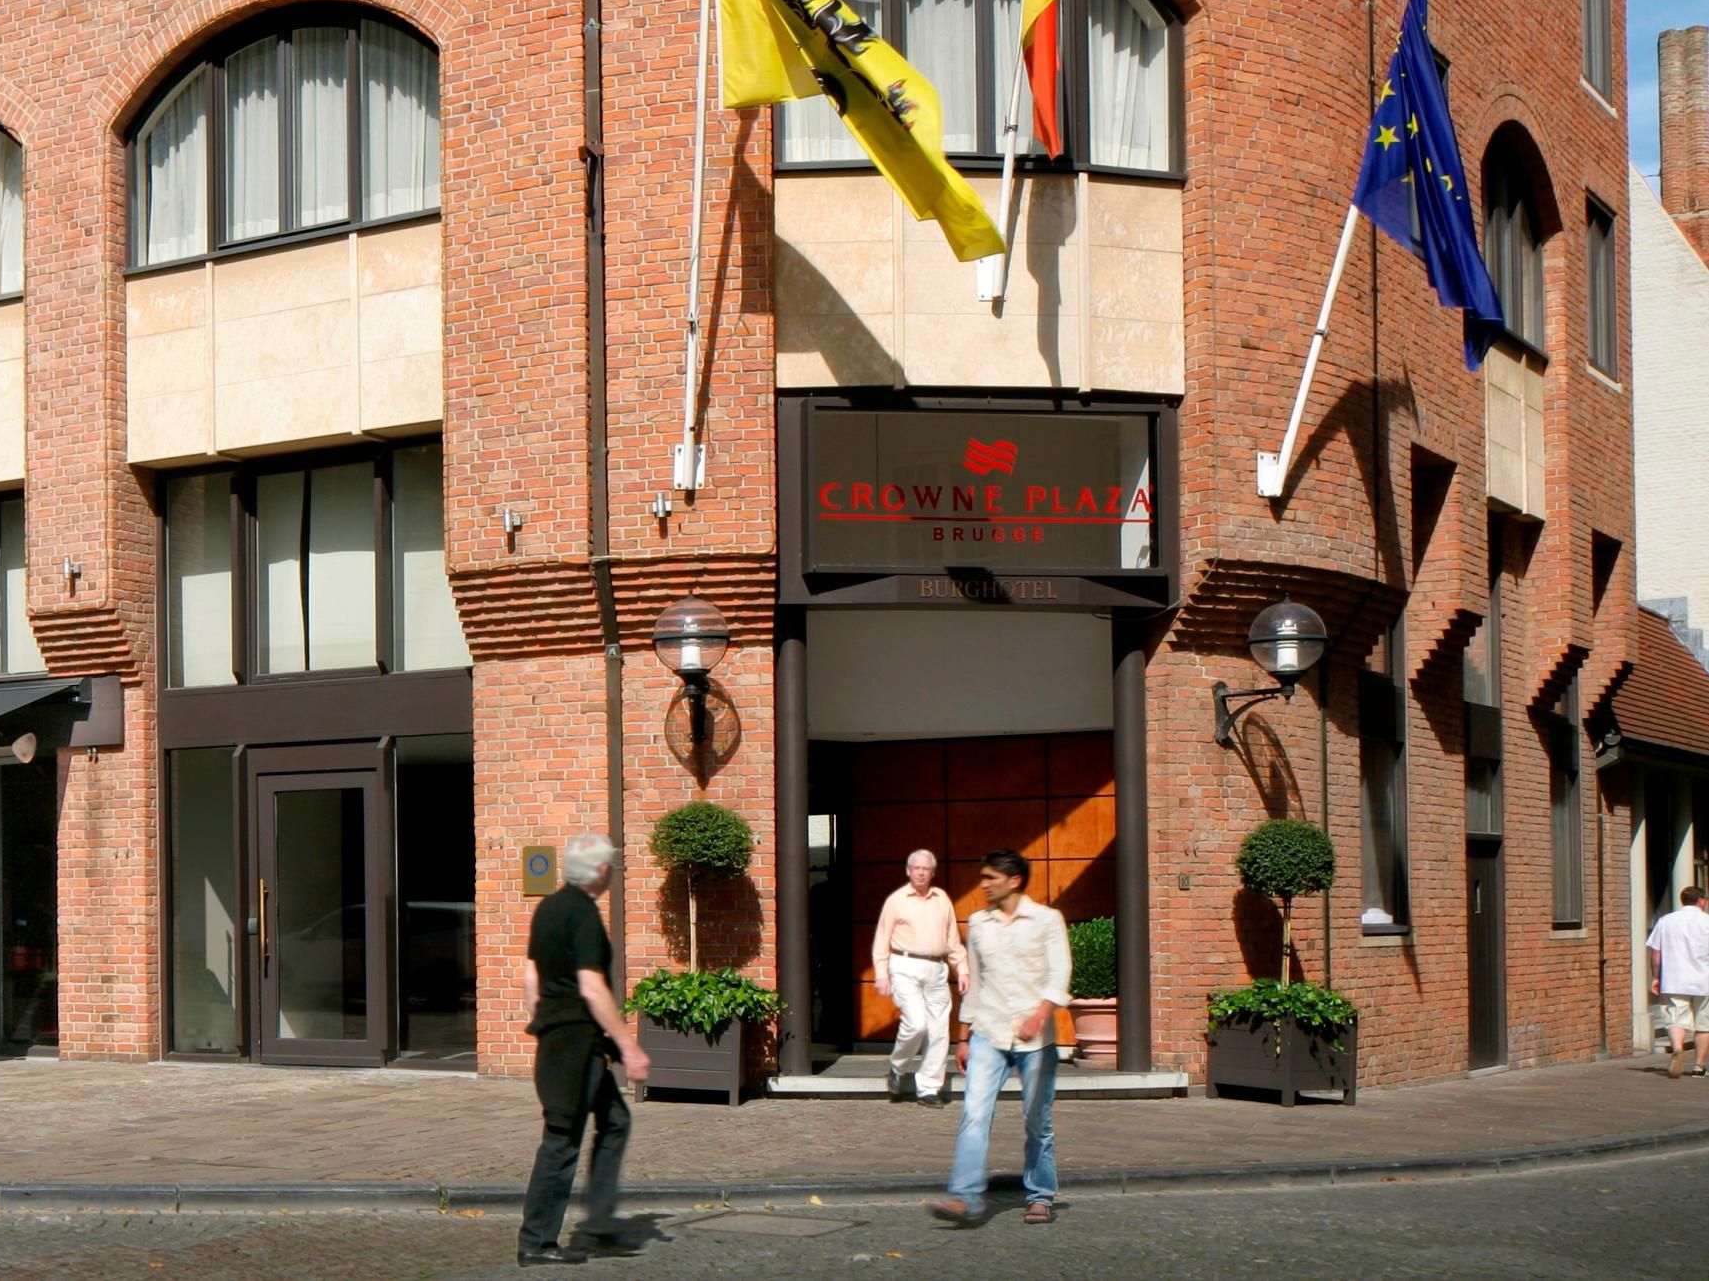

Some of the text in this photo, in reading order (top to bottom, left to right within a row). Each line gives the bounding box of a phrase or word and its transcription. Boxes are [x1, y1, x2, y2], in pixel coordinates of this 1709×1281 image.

[819, 482, 1153, 514] CROWNE PLAZA
[932, 526, 1044, 543] BRUGGE
[919, 578, 1059, 600] BURGHOTEL
